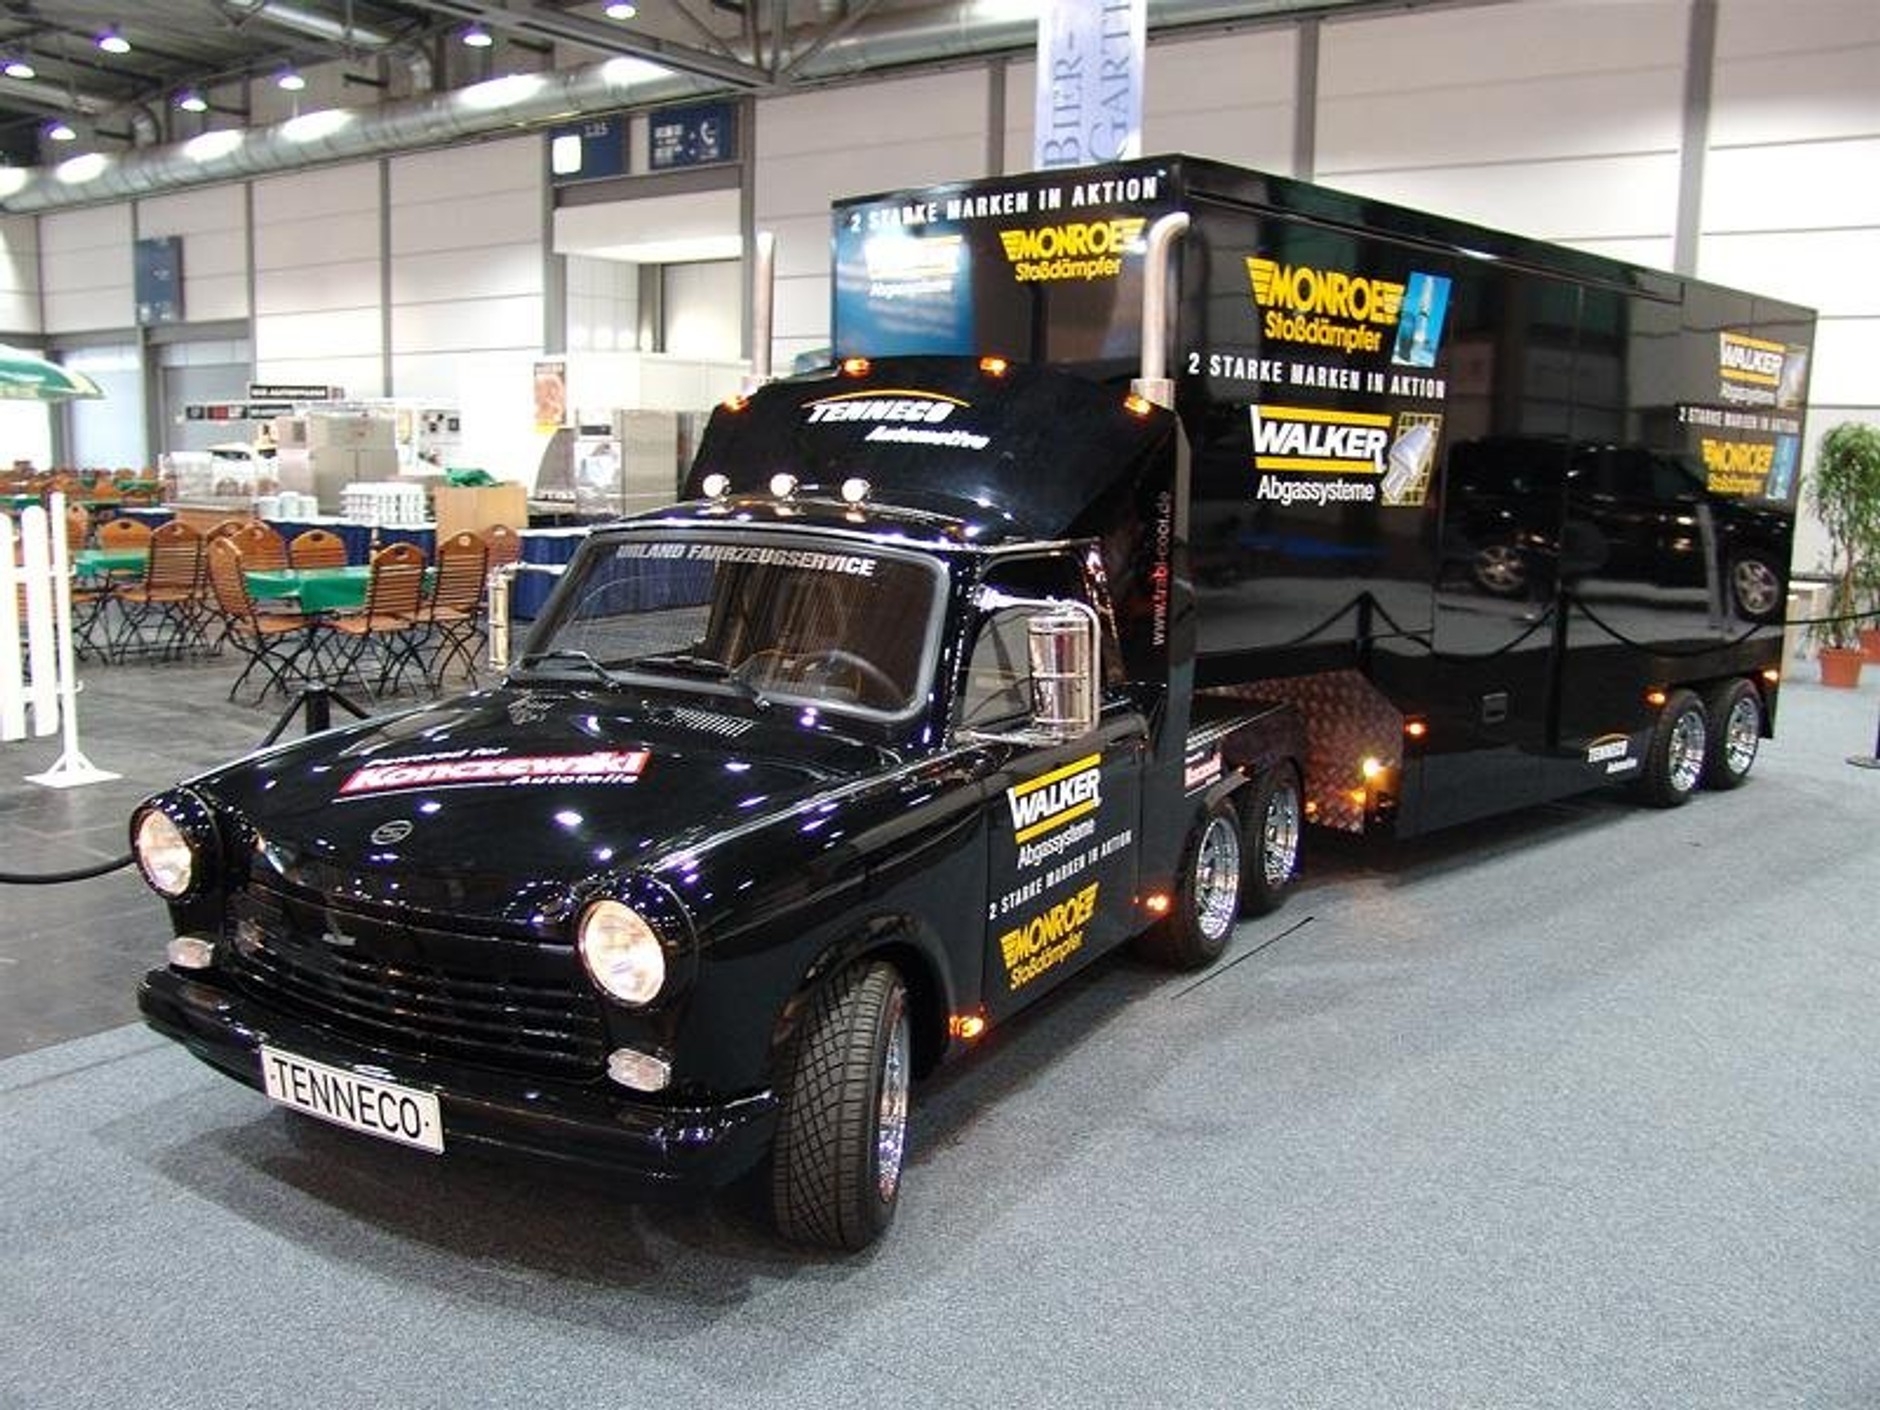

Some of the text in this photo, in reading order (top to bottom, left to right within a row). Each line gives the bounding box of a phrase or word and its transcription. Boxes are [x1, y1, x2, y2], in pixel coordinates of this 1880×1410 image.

[850, 176, 1157, 233] 2 STARKE MARKEN IN AKTION
[1016, 221, 1126, 262] MONROE
[1015, 256, 1122, 282] Stoßdämpfer
[1266, 263, 1388, 323] MONROE
[1264, 309, 1382, 354] Stoßdämpfer
[1188, 352, 1446, 399] 2 STARKE MARKEN IN AKTION
[1720, 332, 1783, 386] WALKER
[808, 400, 956, 424] TENNECO
[1251, 404, 1388, 473] WALKER
[1256, 474, 1376, 506] Abgassysteme
[686, 545, 877, 578] FAHRZEUGSERVICE
[1006, 767, 1102, 831] WALKER
[1017, 818, 1096, 870] Abgassysteme
[988, 902, 998, 921] 2
[1001, 878, 1043, 913] STARKE
[1046, 854, 1085, 889] MARKEN
[1088, 846, 1099, 865] IN
[1014, 890, 1090, 962] MONROE
[1010, 931, 1083, 991] Stoßdämpfer
[271, 1056, 422, 1139] TENNECO
